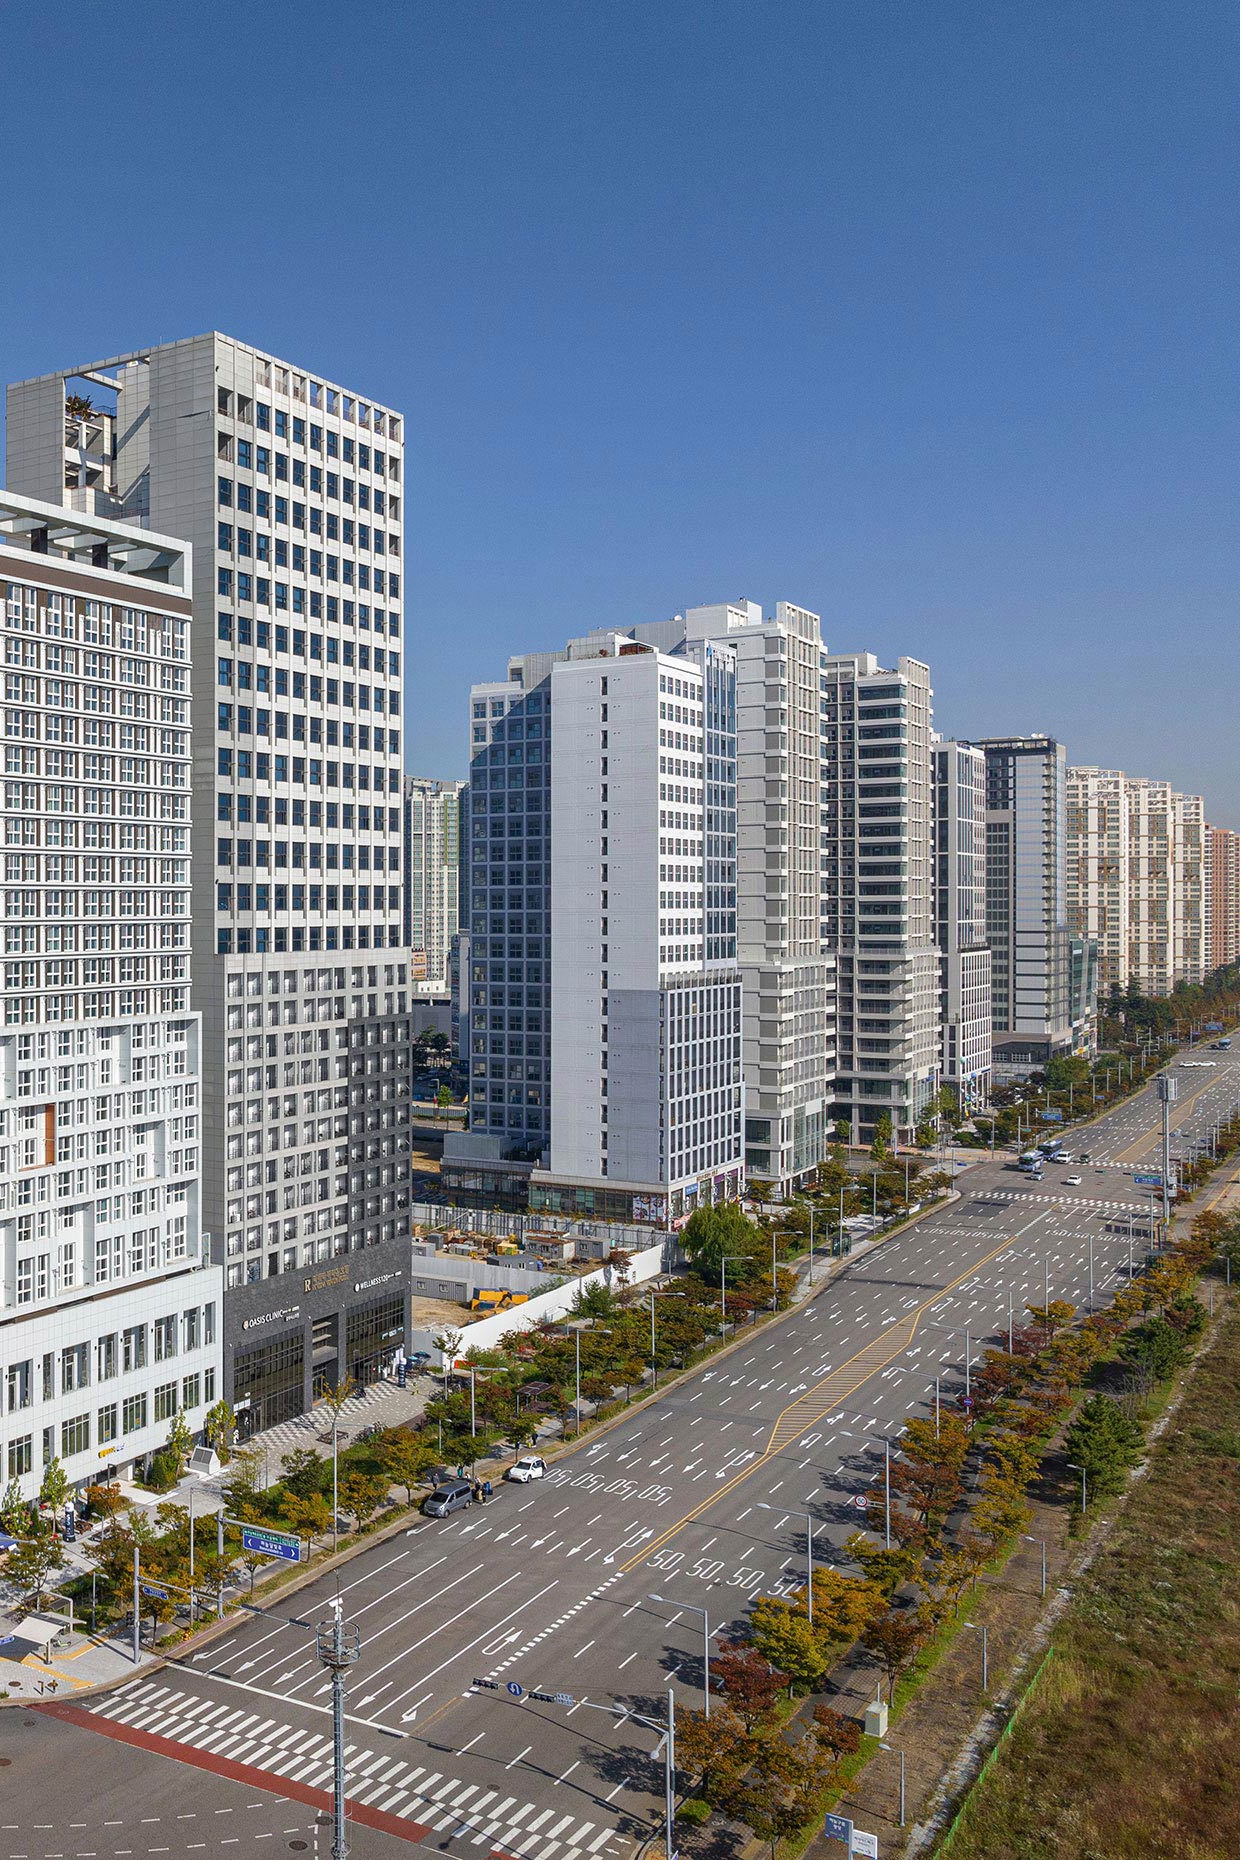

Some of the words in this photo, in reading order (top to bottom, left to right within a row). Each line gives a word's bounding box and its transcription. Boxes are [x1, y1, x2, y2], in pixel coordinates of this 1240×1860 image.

[249, 1315, 265, 1328] OASIS
[265, 1309, 284, 1322] CLINIC
[540, 1468, 573, 1483] 50
[570, 1472, 605, 1489] 50
[603, 1479, 638, 1494] 50
[637, 1484, 673, 1501] 50
[646, 1549, 685, 1570] 50
[686, 1558, 725, 1579] 50
[726, 1567, 765, 1589] 50
[767, 1576, 806, 1598] 50
